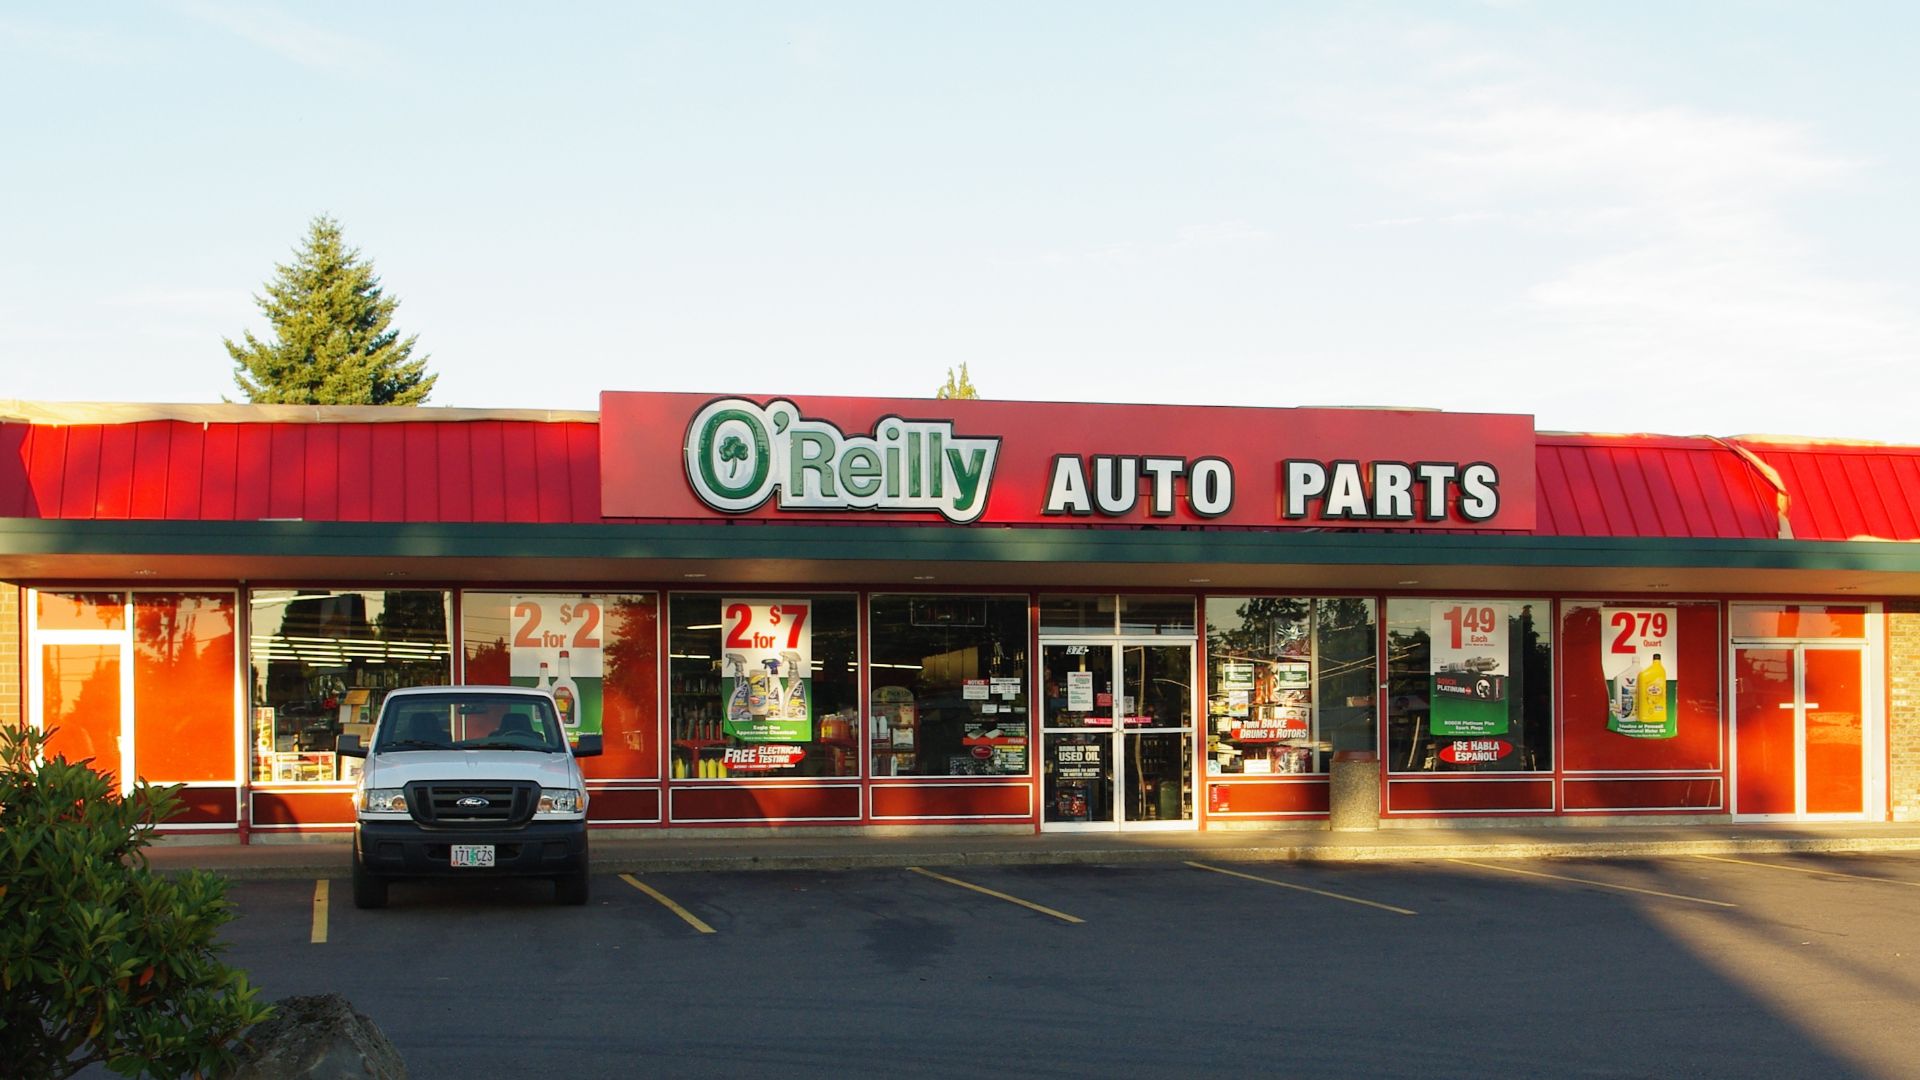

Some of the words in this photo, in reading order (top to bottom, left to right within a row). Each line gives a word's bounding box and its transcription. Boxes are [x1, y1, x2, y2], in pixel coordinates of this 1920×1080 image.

[1046, 456, 1233, 515] AUTO
[1288, 461, 1498, 519] PARTS
[514, 602, 542, 648] 2
[543, 630, 566, 648] for
[725, 603, 752, 649] 2
[753, 632, 775, 648] for
[769, 604, 808, 649] $7
[1643, 639, 1662, 647] Quart
[1269, 730, 1275, 738] &
[1471, 741, 1500, 751] HABLA
[724, 748, 757, 763] FREE
[758, 746, 802, 755] ELECTRICAL
[759, 755, 790, 763] TESTING
[1059, 752, 1083, 761] USED
[1085, 752, 1100, 761] OIL
